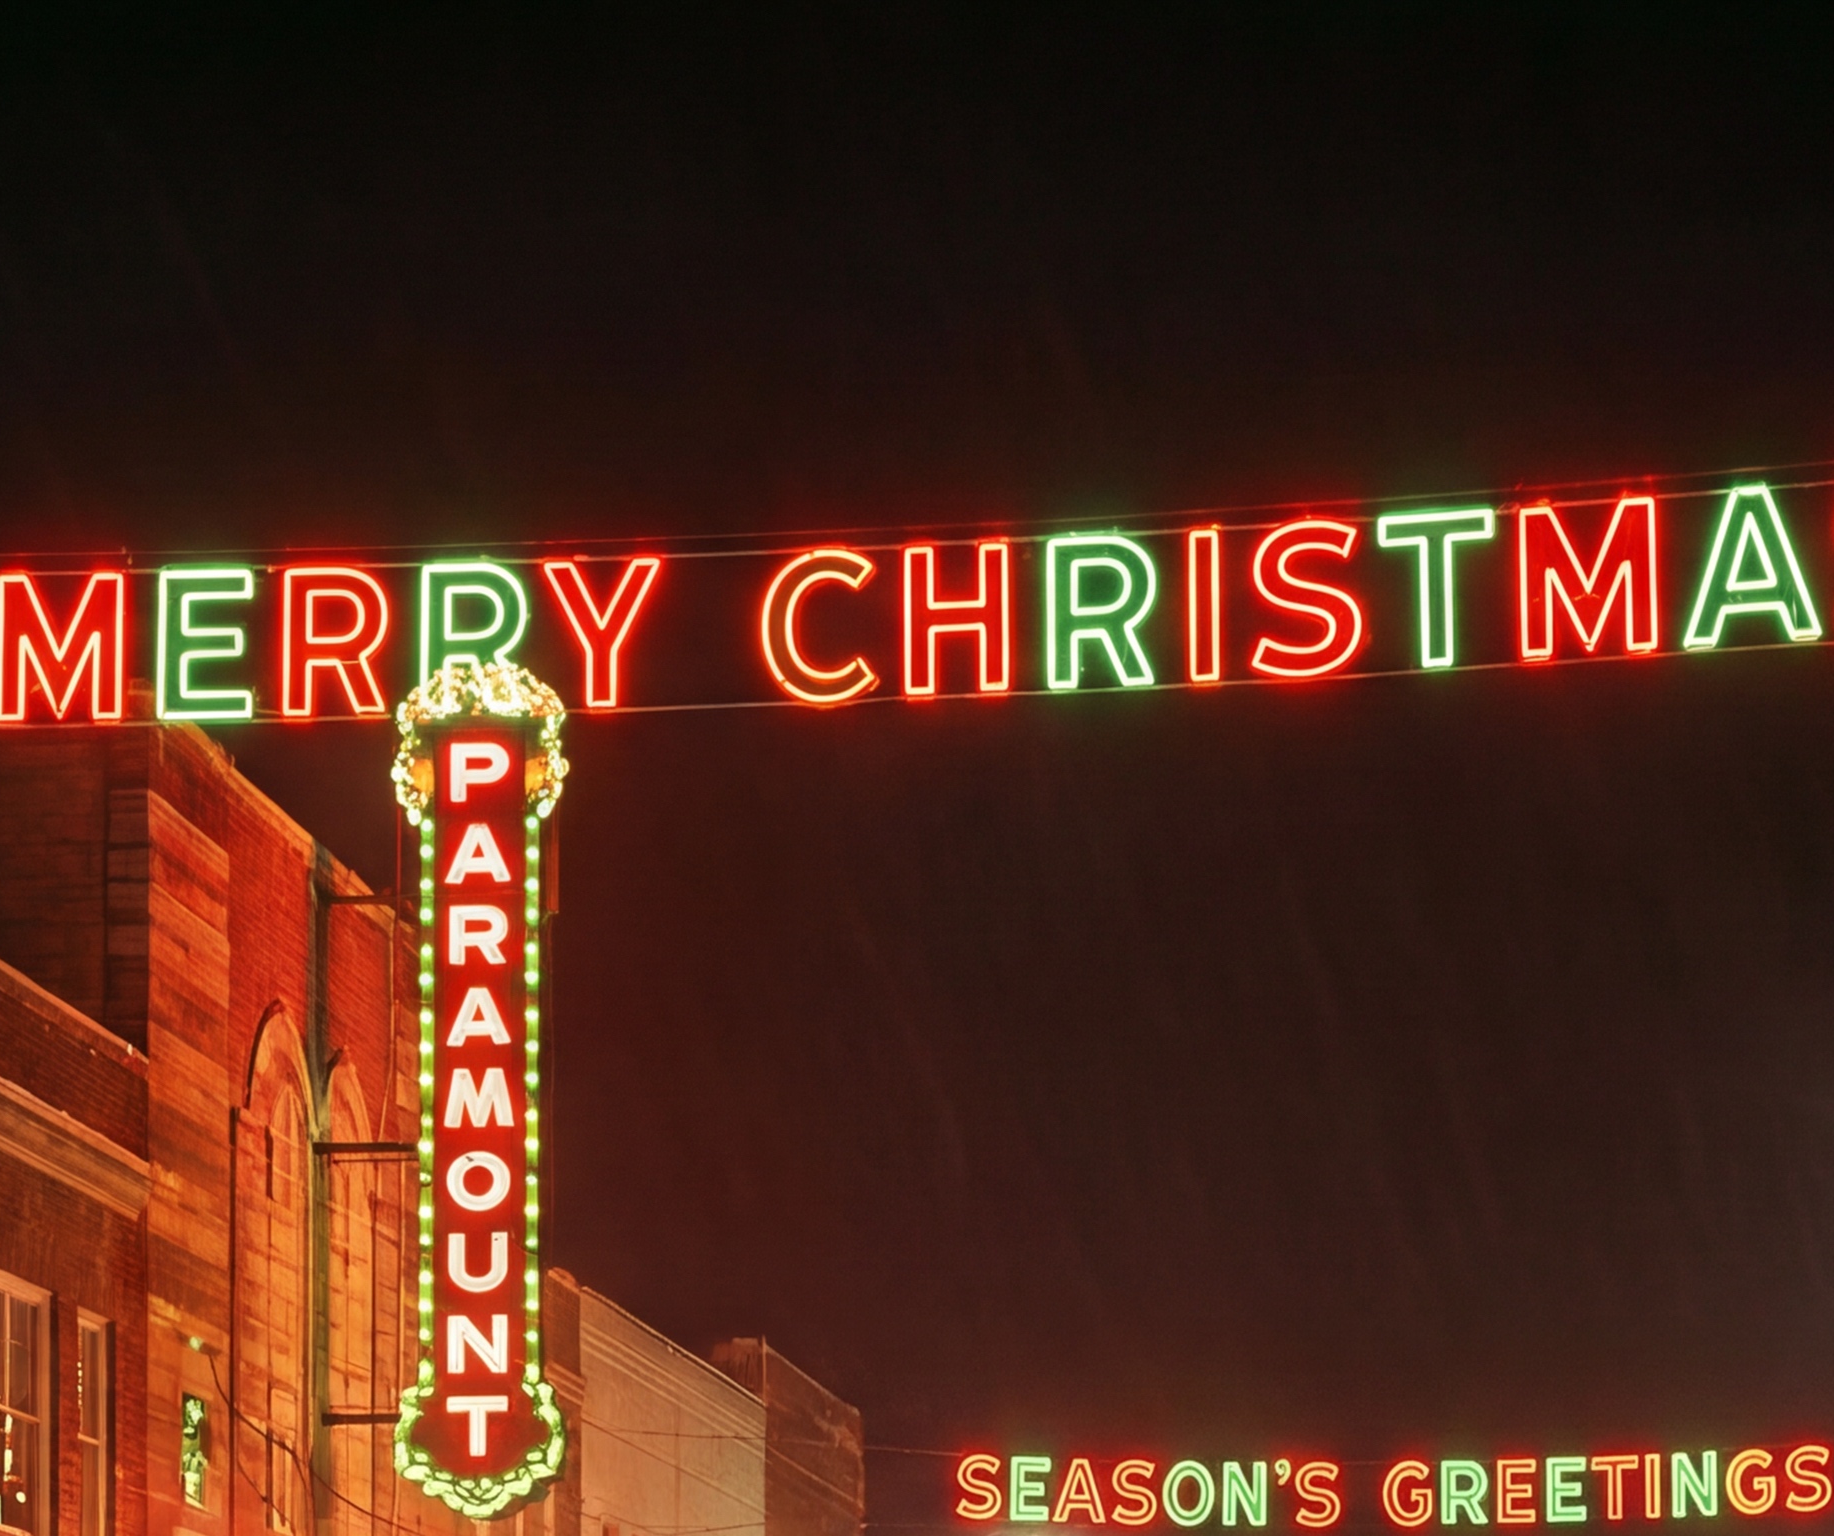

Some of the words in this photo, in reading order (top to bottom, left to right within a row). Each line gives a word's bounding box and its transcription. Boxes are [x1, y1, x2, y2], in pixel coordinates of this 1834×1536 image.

[444, 741, 514, 1458] PARAMOUNT
[955, 1453, 1343, 1528] SEASON'S
[1382, 1444, 1834, 1528] GREETINGS
